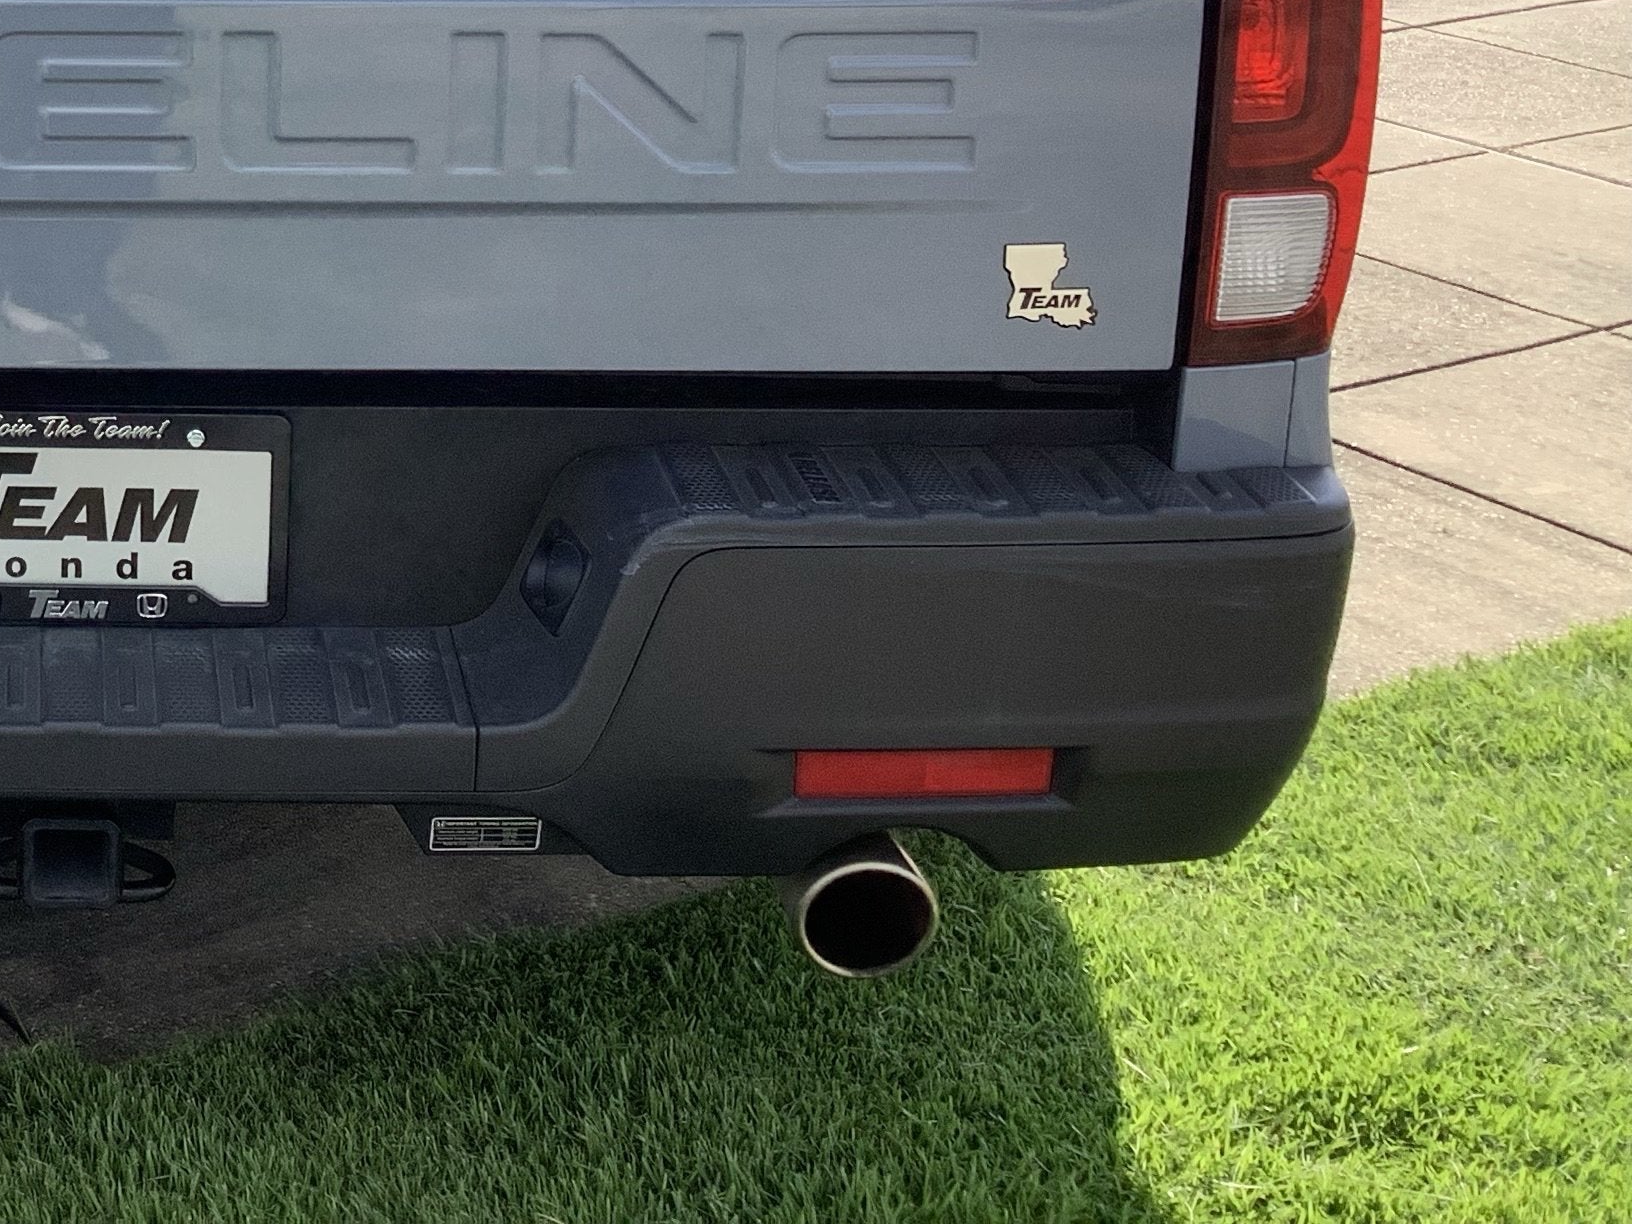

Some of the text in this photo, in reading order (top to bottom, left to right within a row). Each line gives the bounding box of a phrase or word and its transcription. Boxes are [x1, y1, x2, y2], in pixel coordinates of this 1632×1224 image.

[1019, 287, 1082, 310] TEAM
[37, 415, 87, 440] The
[87, 416, 171, 441] Team!
[28, 588, 110, 620] TEAM
